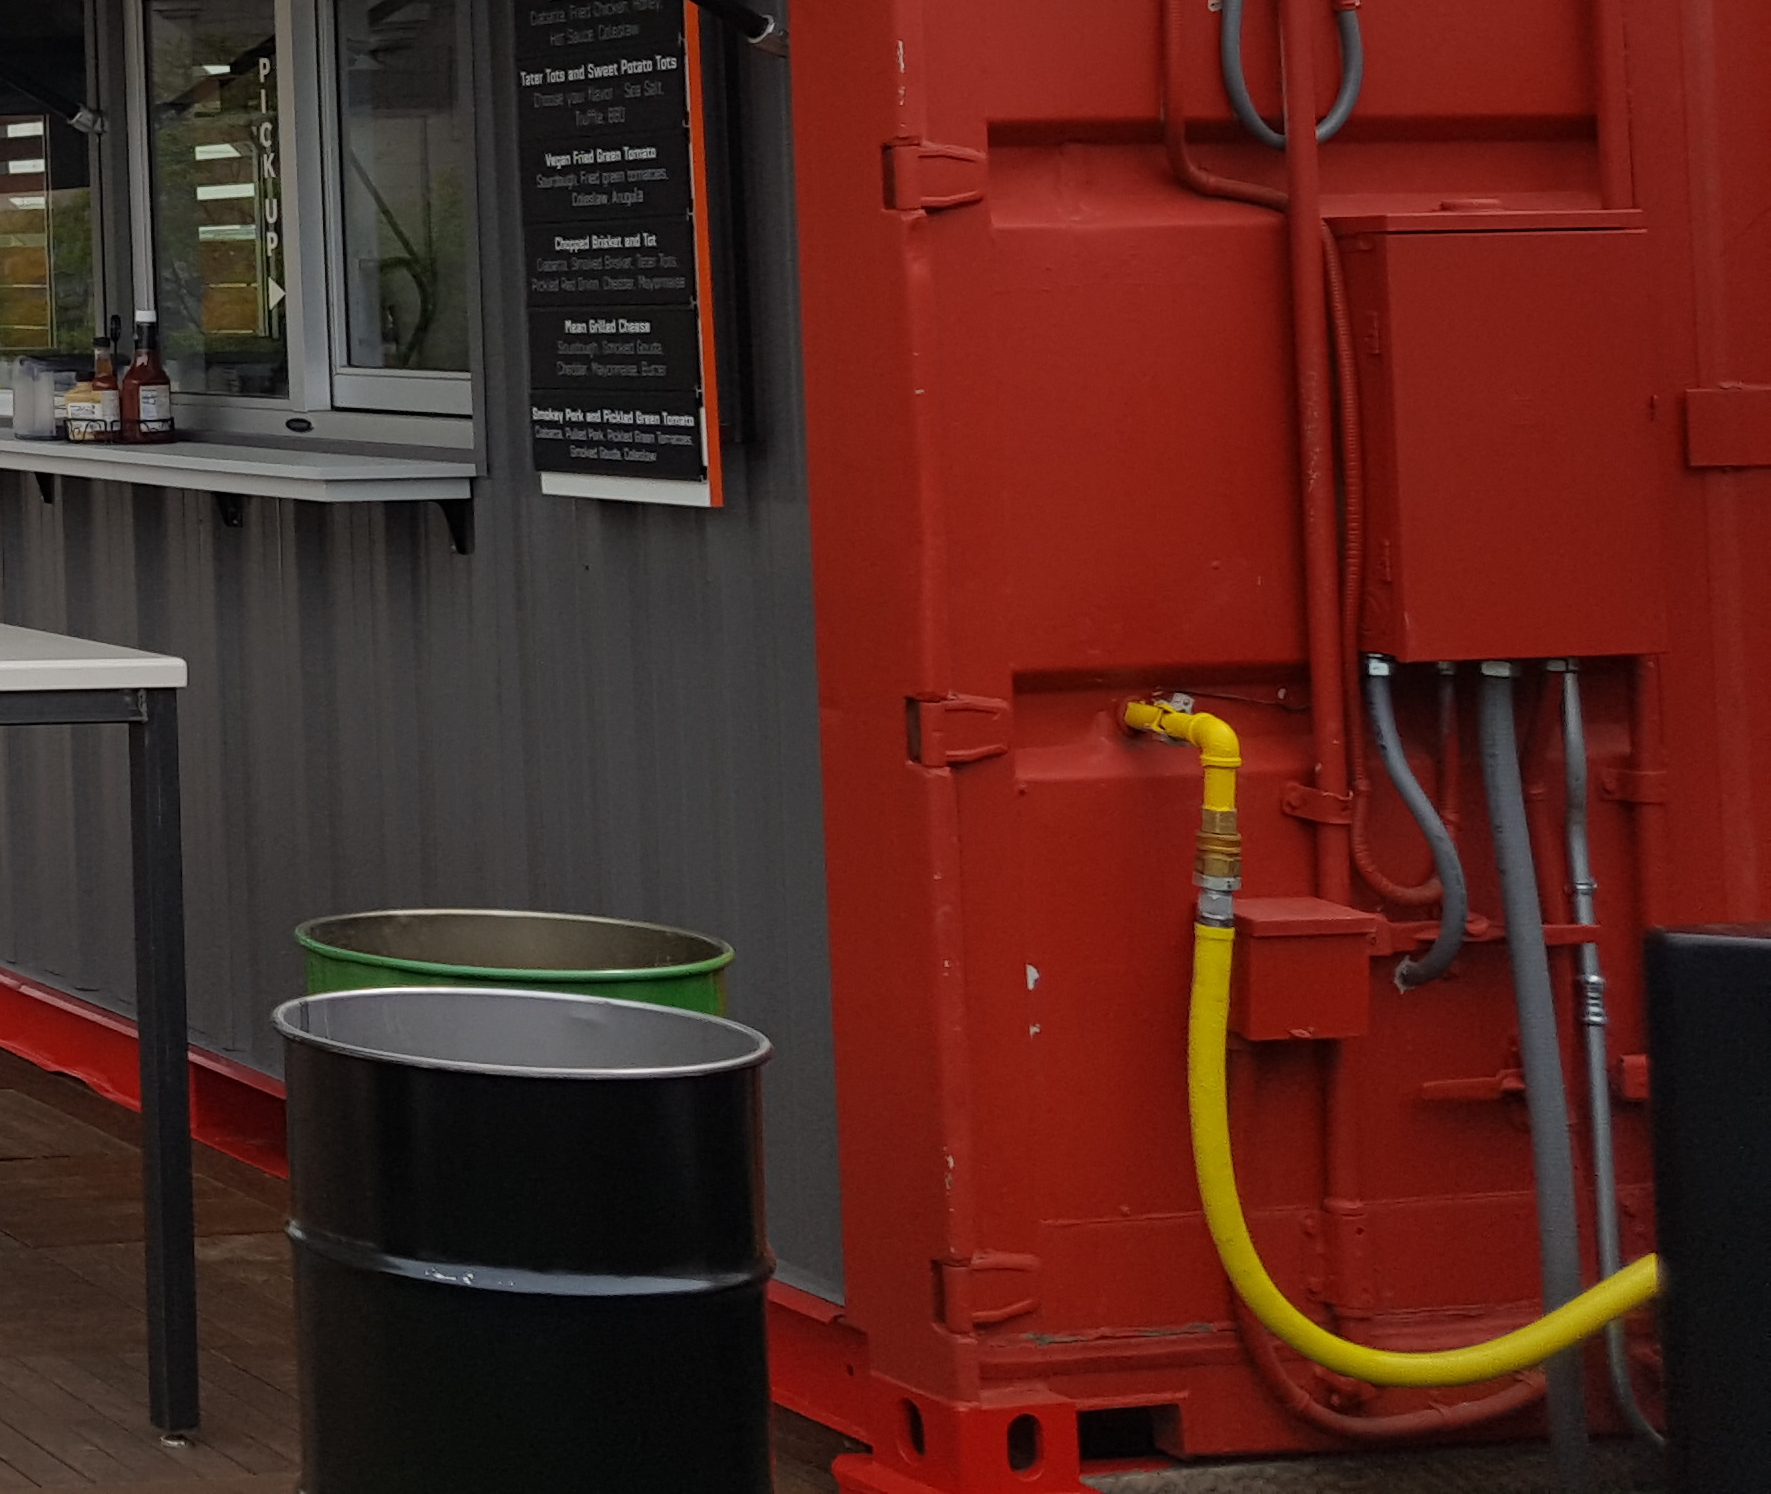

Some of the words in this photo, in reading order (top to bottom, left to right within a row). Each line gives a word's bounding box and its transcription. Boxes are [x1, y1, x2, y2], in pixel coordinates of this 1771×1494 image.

[520, 71, 543, 86] Tater
[545, 68, 565, 83] Tots
[568, 65, 585, 81] and
[588, 63, 618, 79] Sweet
[620, 59, 653, 75] Potato
[655, 55, 677, 71] Tots
[259, 57, 276, 179] PICK
[545, 152, 571, 170] Vegan
[573, 150, 594, 165] Fried
[597, 148, 621, 163] Green
[623, 146, 657, 161] Tomato
[264, 198, 279, 257] UP
[555, 235, 590, 253] Chopped
[592, 234, 623, 249] Brisket
[624, 233, 641, 248] and
[564, 320, 587, 334] Mean
[589, 319, 616, 334] Grilled
[618, 319, 651, 334] Cheese
[565, 408, 584, 422] Pork
[586, 410, 601, 423] and
[603, 409, 633, 424] Pickled
[635, 410, 660, 425] Green
[661, 411, 694, 427] Tomato
